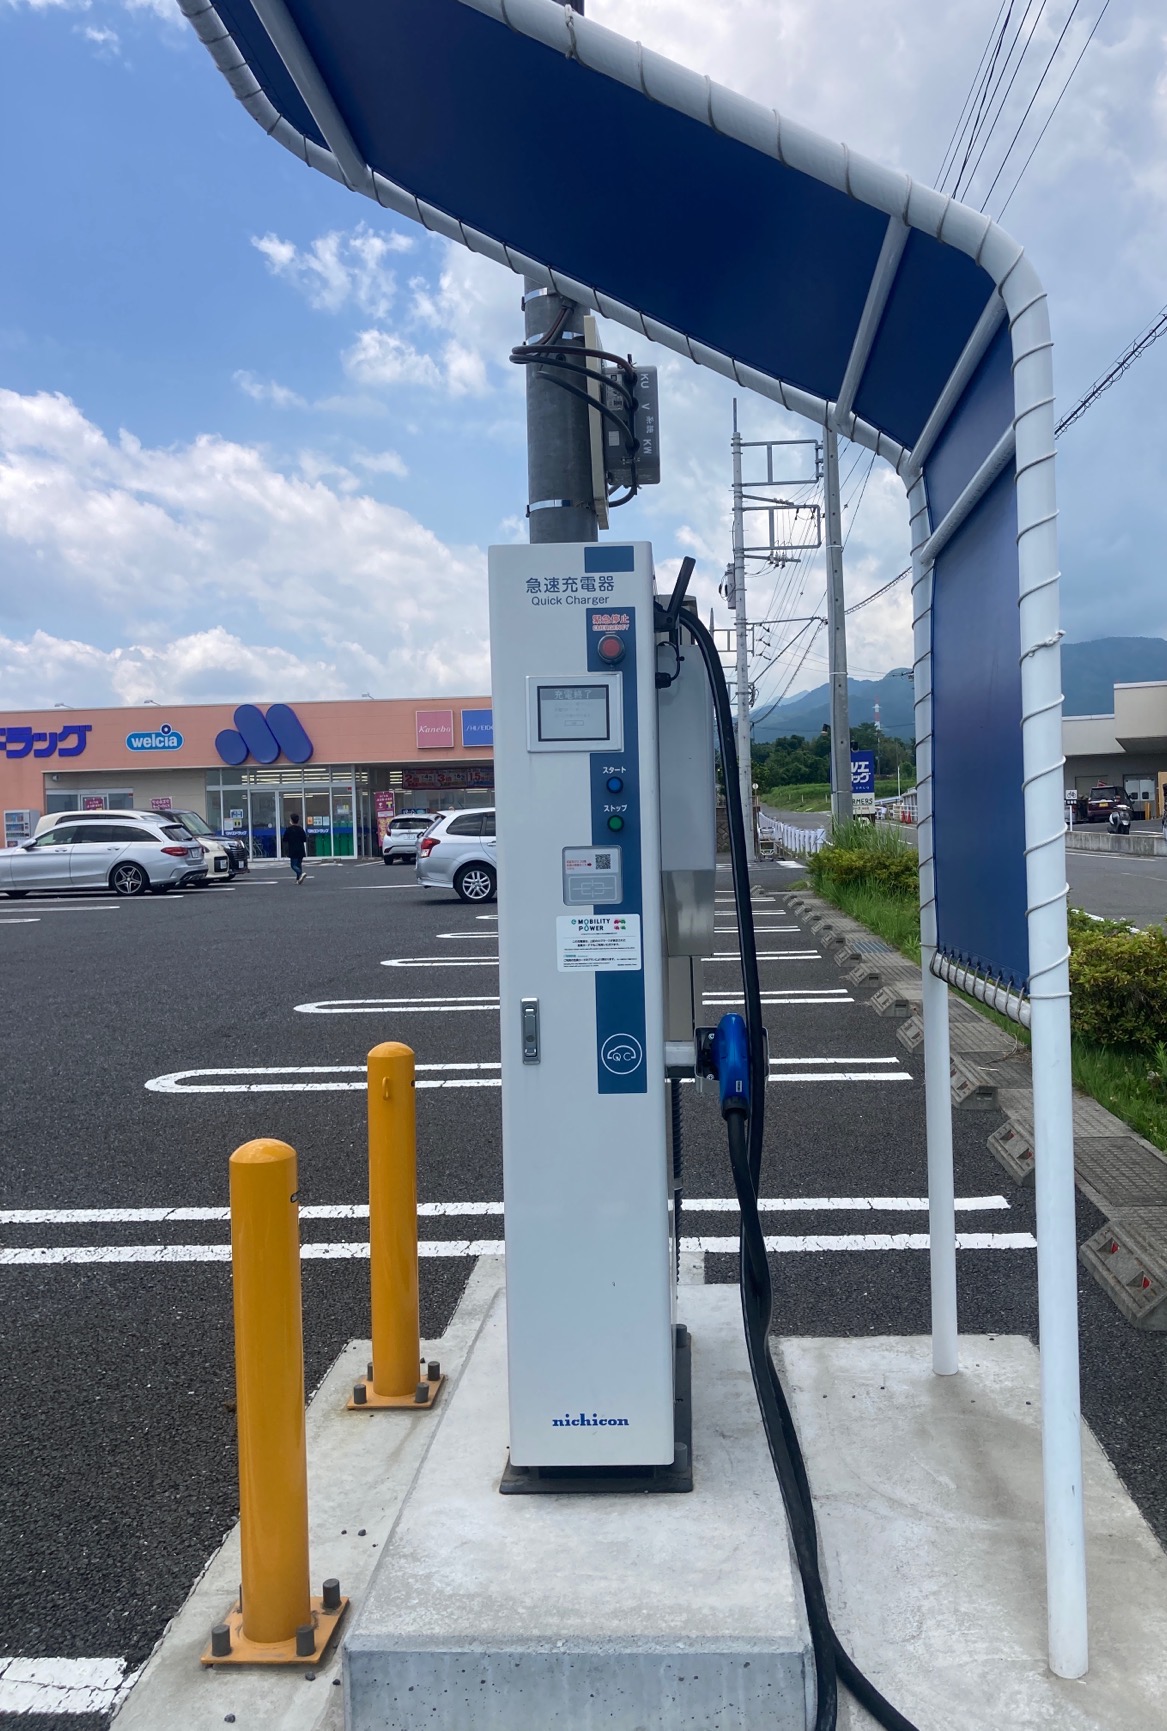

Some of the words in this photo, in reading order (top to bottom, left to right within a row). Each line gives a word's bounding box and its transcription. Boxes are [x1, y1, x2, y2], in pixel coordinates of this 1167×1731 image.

[640, 373, 649, 389] KU
[643, 439, 652, 454] KW
[525, 575, 615, 594] 急速充電器
[531, 596, 562, 606] Quick
[565, 595, 609, 605] Charger
[418, 725, 451, 733] Kanebo
[131, 733, 178, 748] welcia
[602, 766, 627, 774] スタート
[603, 804, 628, 812] ストップ
[552, 1413, 629, 1427] nichicon
